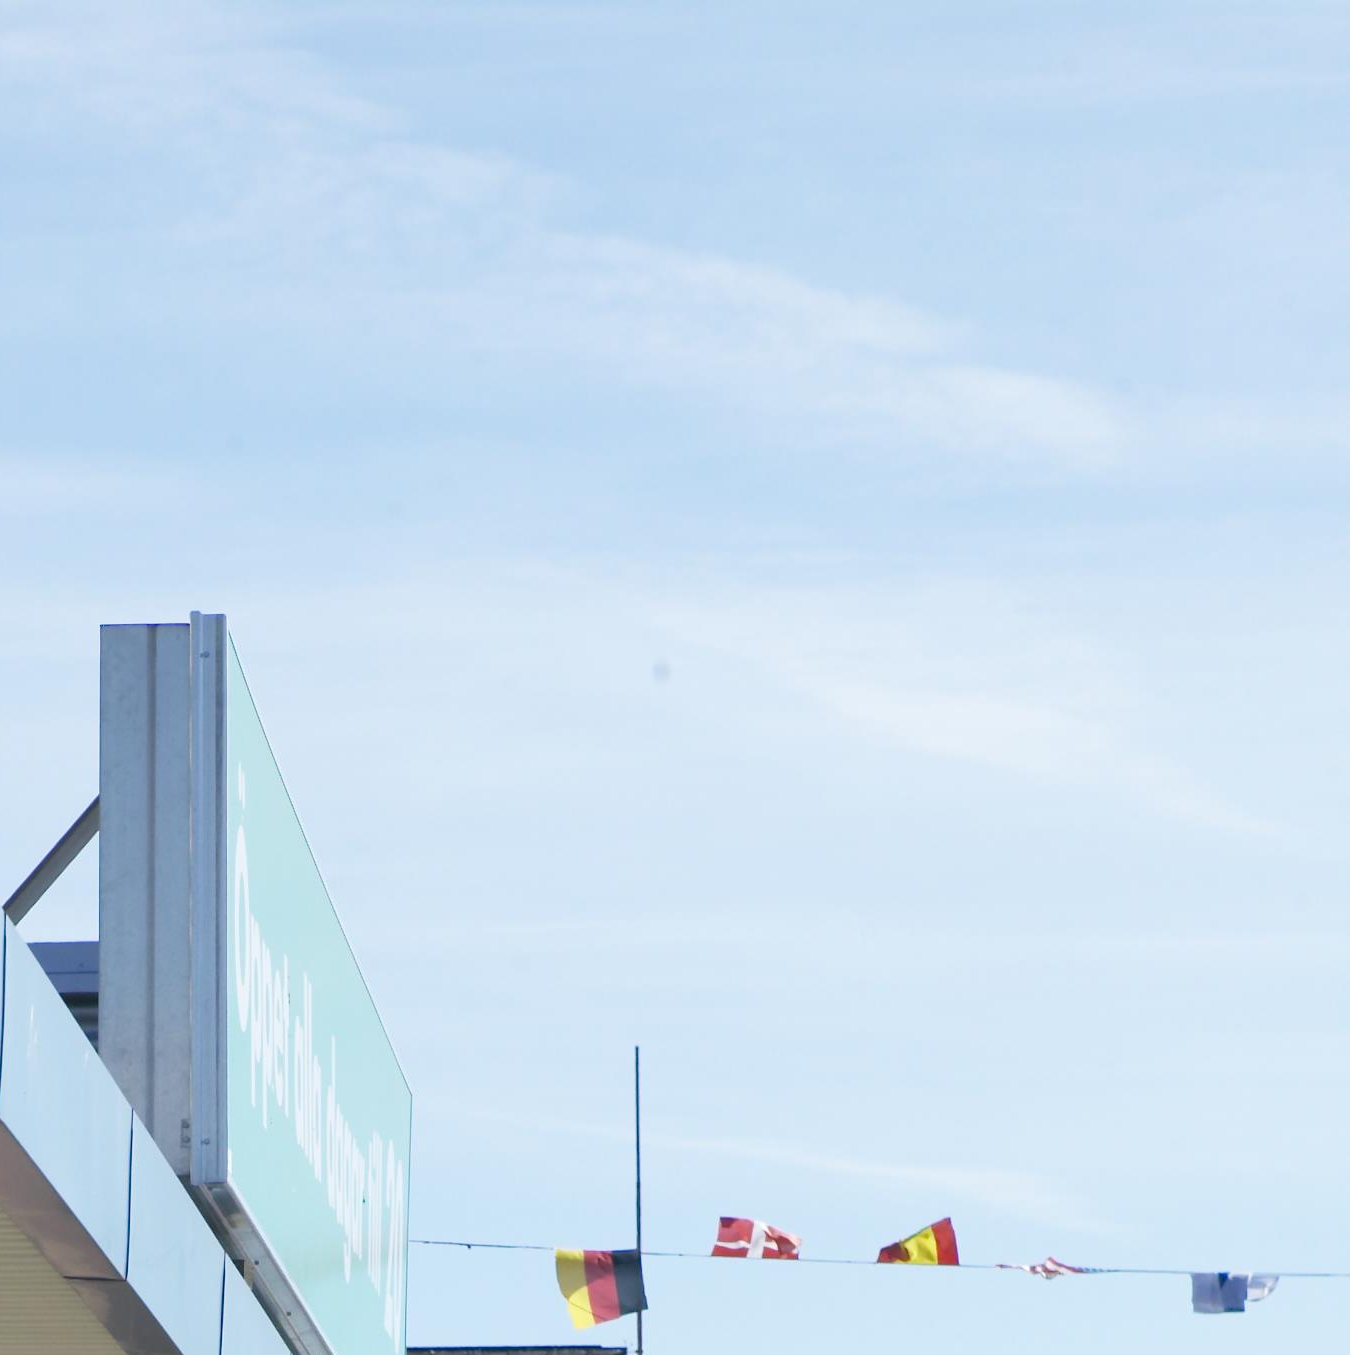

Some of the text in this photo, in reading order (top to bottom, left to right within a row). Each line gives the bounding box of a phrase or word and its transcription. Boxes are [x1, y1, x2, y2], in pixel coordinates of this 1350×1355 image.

[234, 761, 404, 1354] Öppet alla dagar till 20
